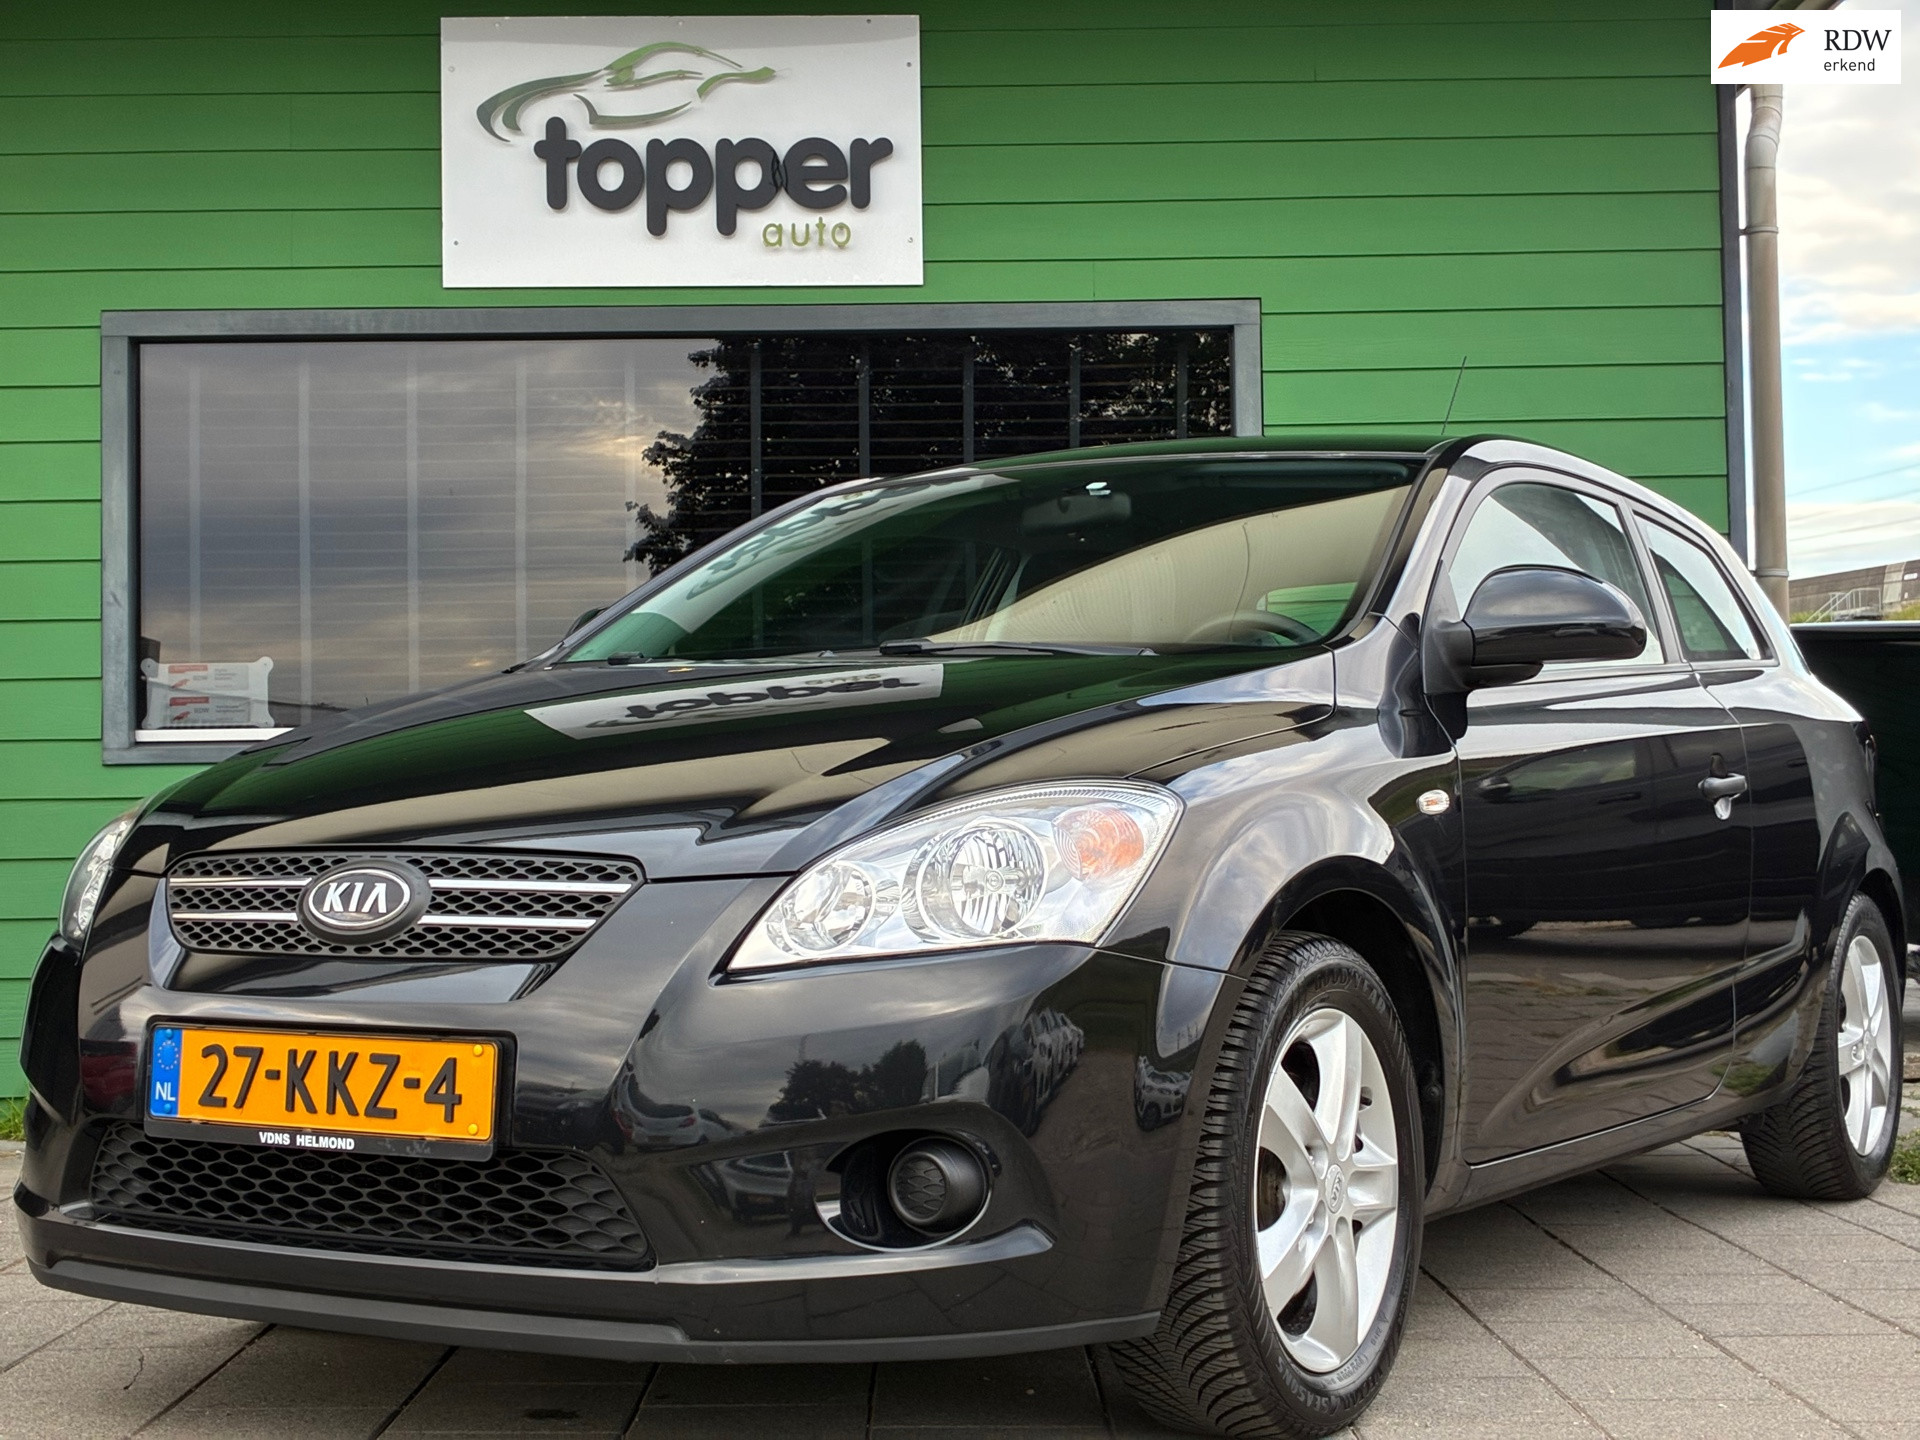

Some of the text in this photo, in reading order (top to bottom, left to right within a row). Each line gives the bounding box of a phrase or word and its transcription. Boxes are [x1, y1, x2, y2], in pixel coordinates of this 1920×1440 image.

[534, 117, 894, 236] topper
[762, 217, 851, 248] auto
[322, 881, 387, 914] KIA
[155, 1081, 176, 1101] NL
[198, 1043, 462, 1123] 27-KKZ-4
[259, 1131, 355, 1150] VDNS HELMOND
